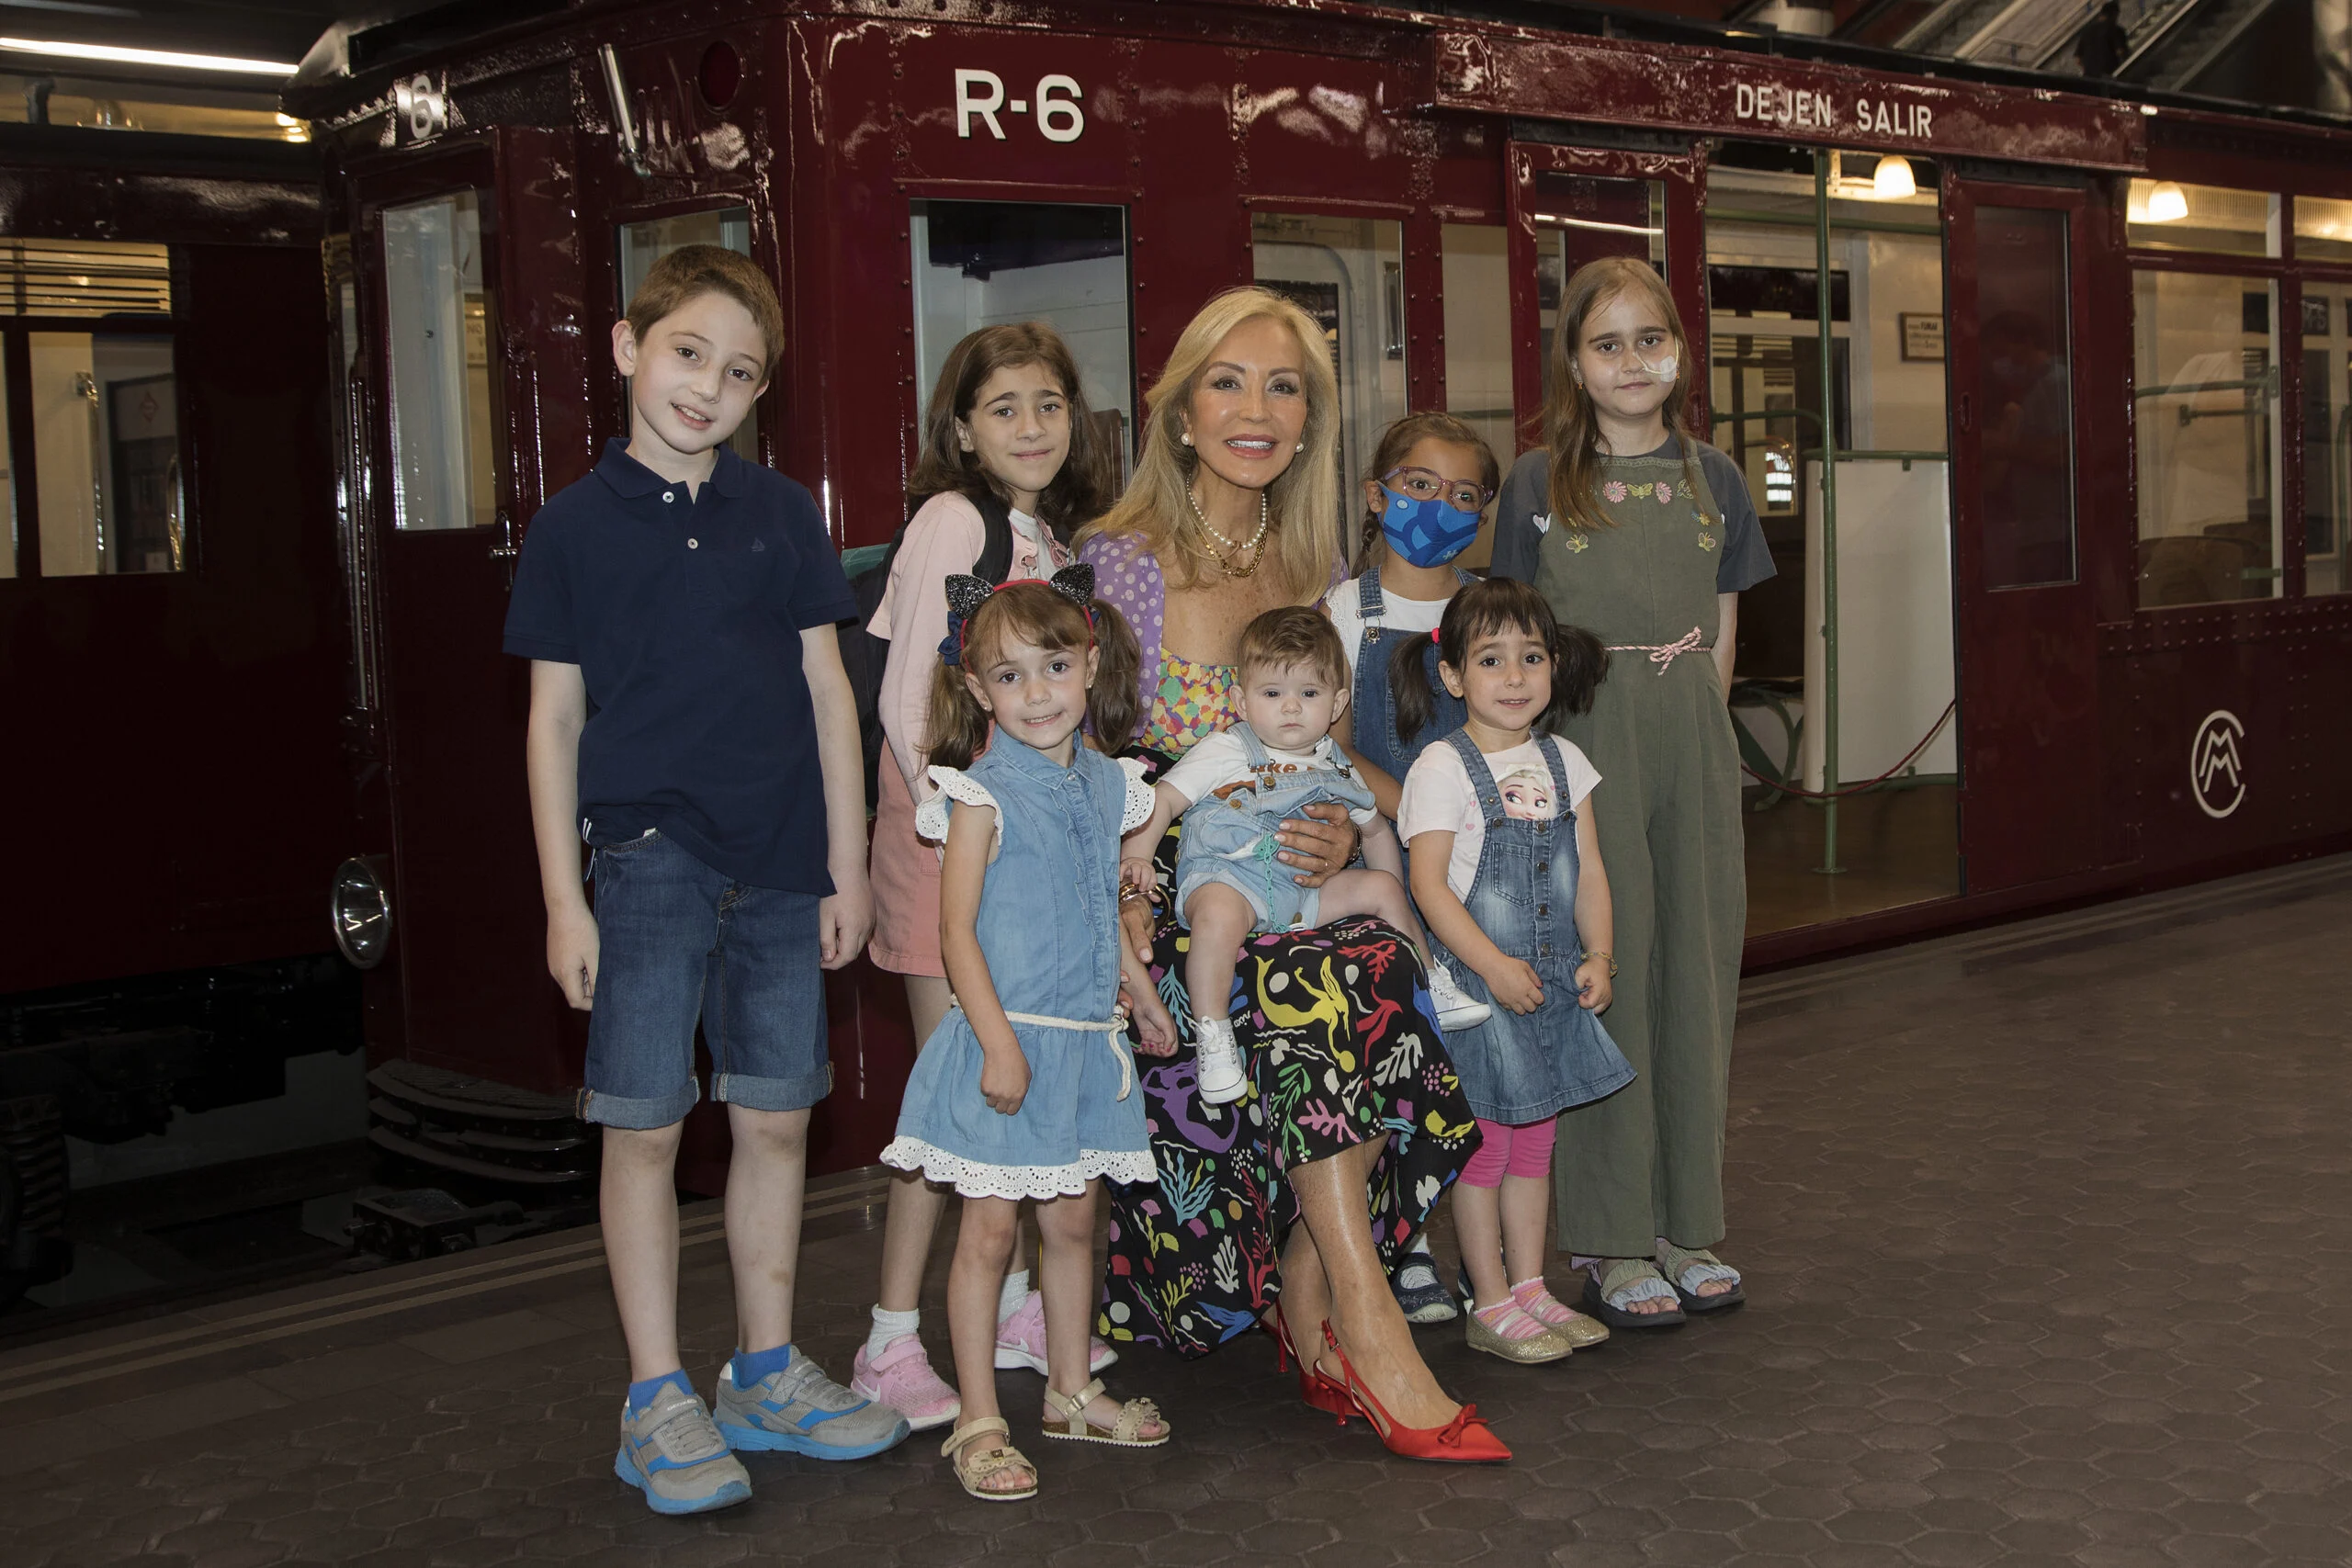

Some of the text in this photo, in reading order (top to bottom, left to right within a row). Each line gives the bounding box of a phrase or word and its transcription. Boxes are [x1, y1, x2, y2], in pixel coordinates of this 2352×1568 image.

[411, 74, 433, 140] 6
[956, 68, 1085, 143] R-6
[1736, 84, 1933, 138] DEJEN SALIR
